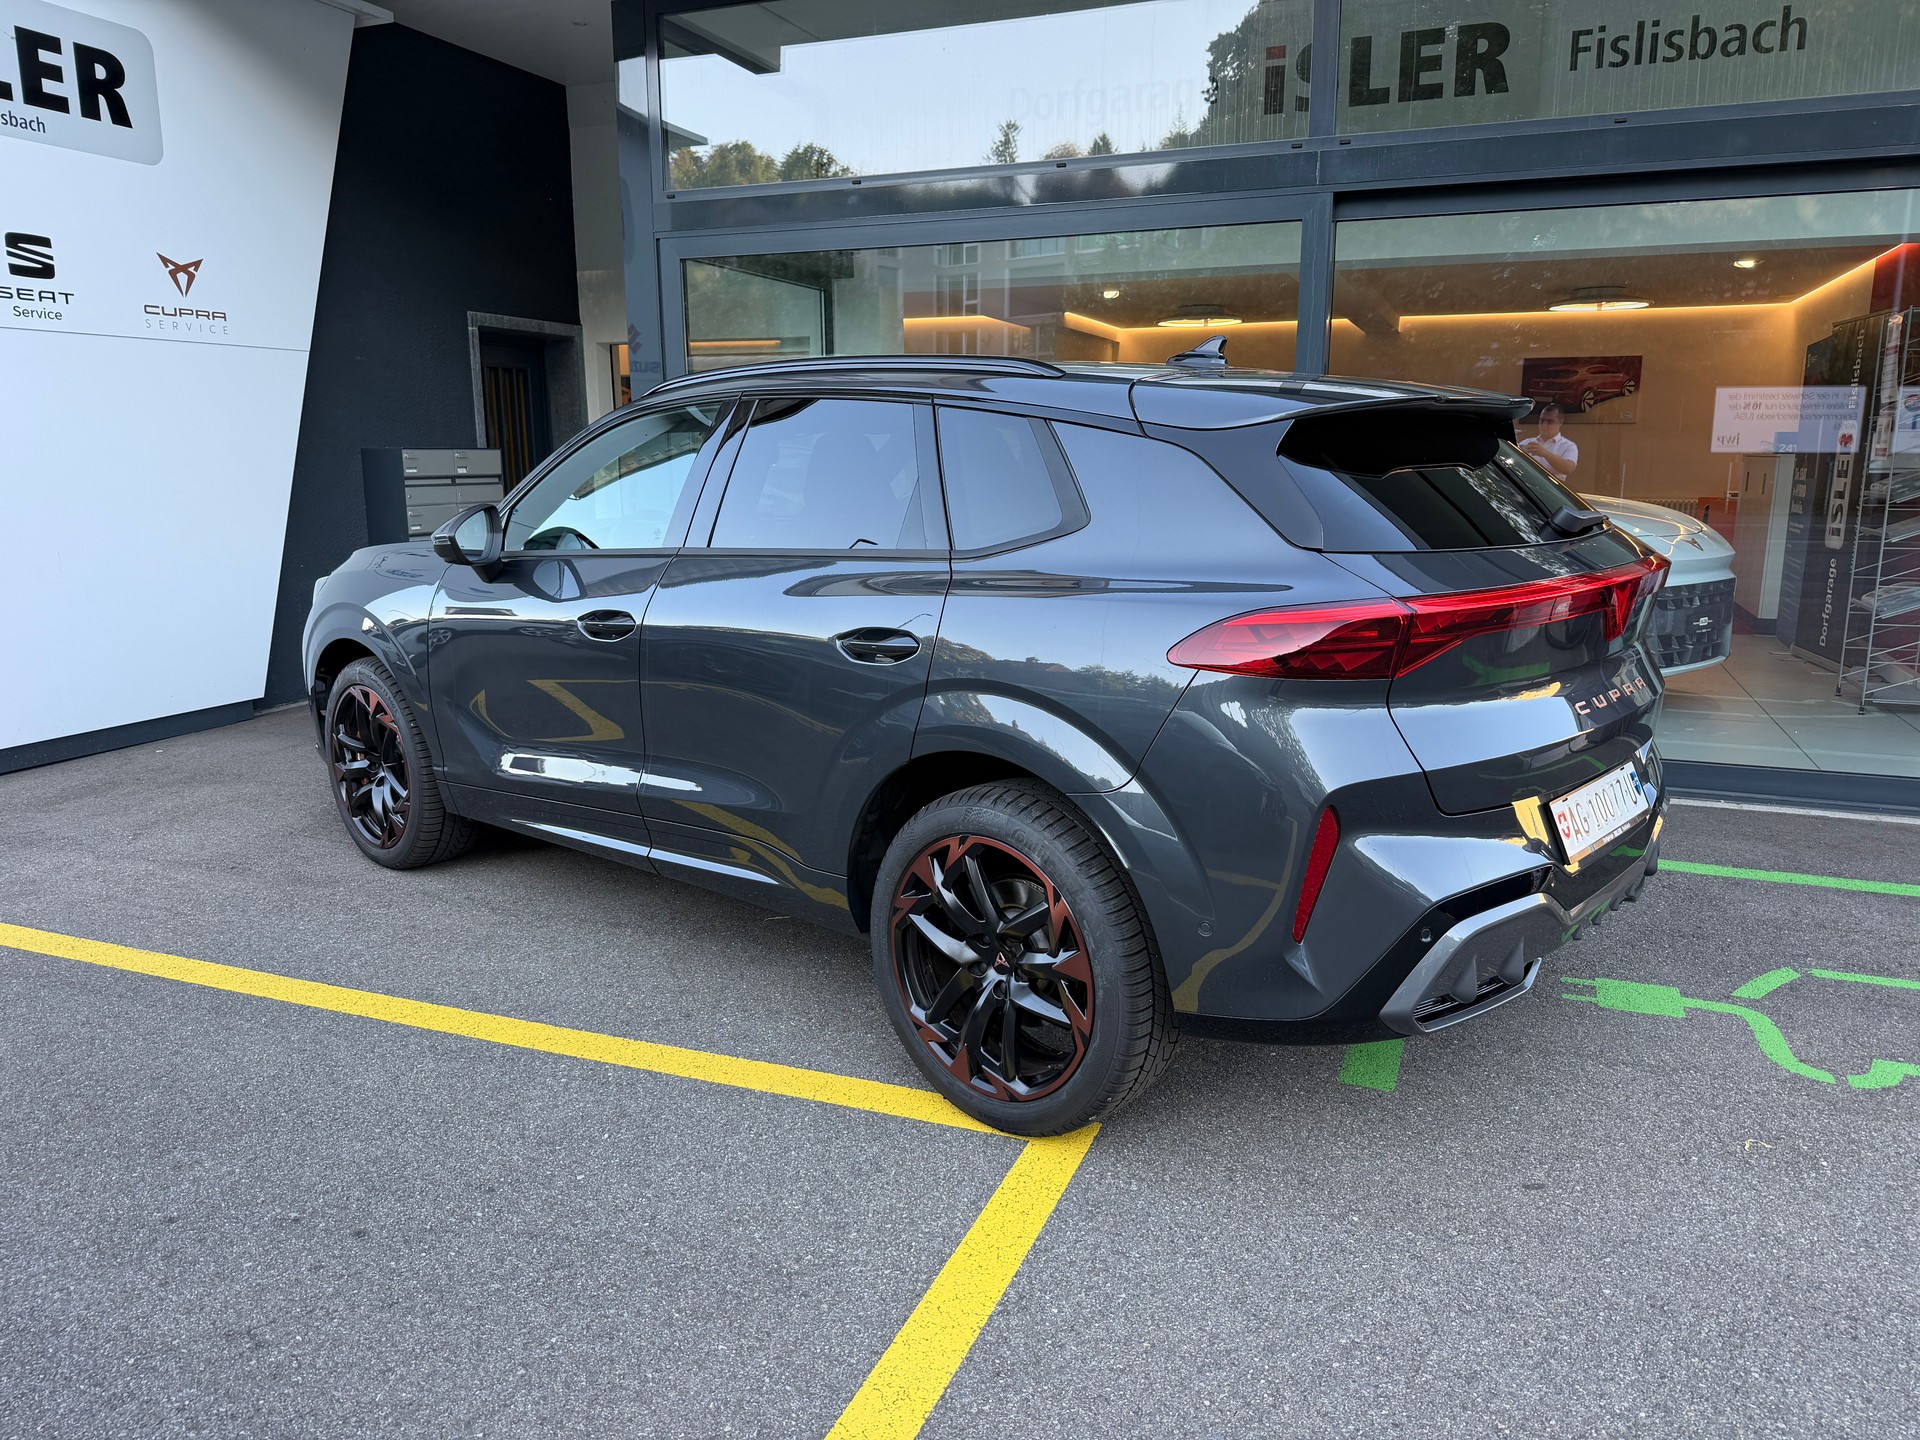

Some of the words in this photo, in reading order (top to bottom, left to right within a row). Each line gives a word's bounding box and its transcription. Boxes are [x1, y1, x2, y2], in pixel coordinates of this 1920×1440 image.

[1569, 5, 1808, 72] Fislisbach
[0, 110, 46, 133] sbach
[0, 286, 75, 305] SEAT
[13, 305, 63, 320] Service
[144, 304, 227, 322] CUPRA
[145, 319, 229, 335] SERVICE
[1819, 558, 1837, 647] Dorfgarage
[1828, 437, 1852, 537] iSLE
[1848, 329, 1865, 409] Fislisbach
[1574, 676, 1647, 716] CUPRA
